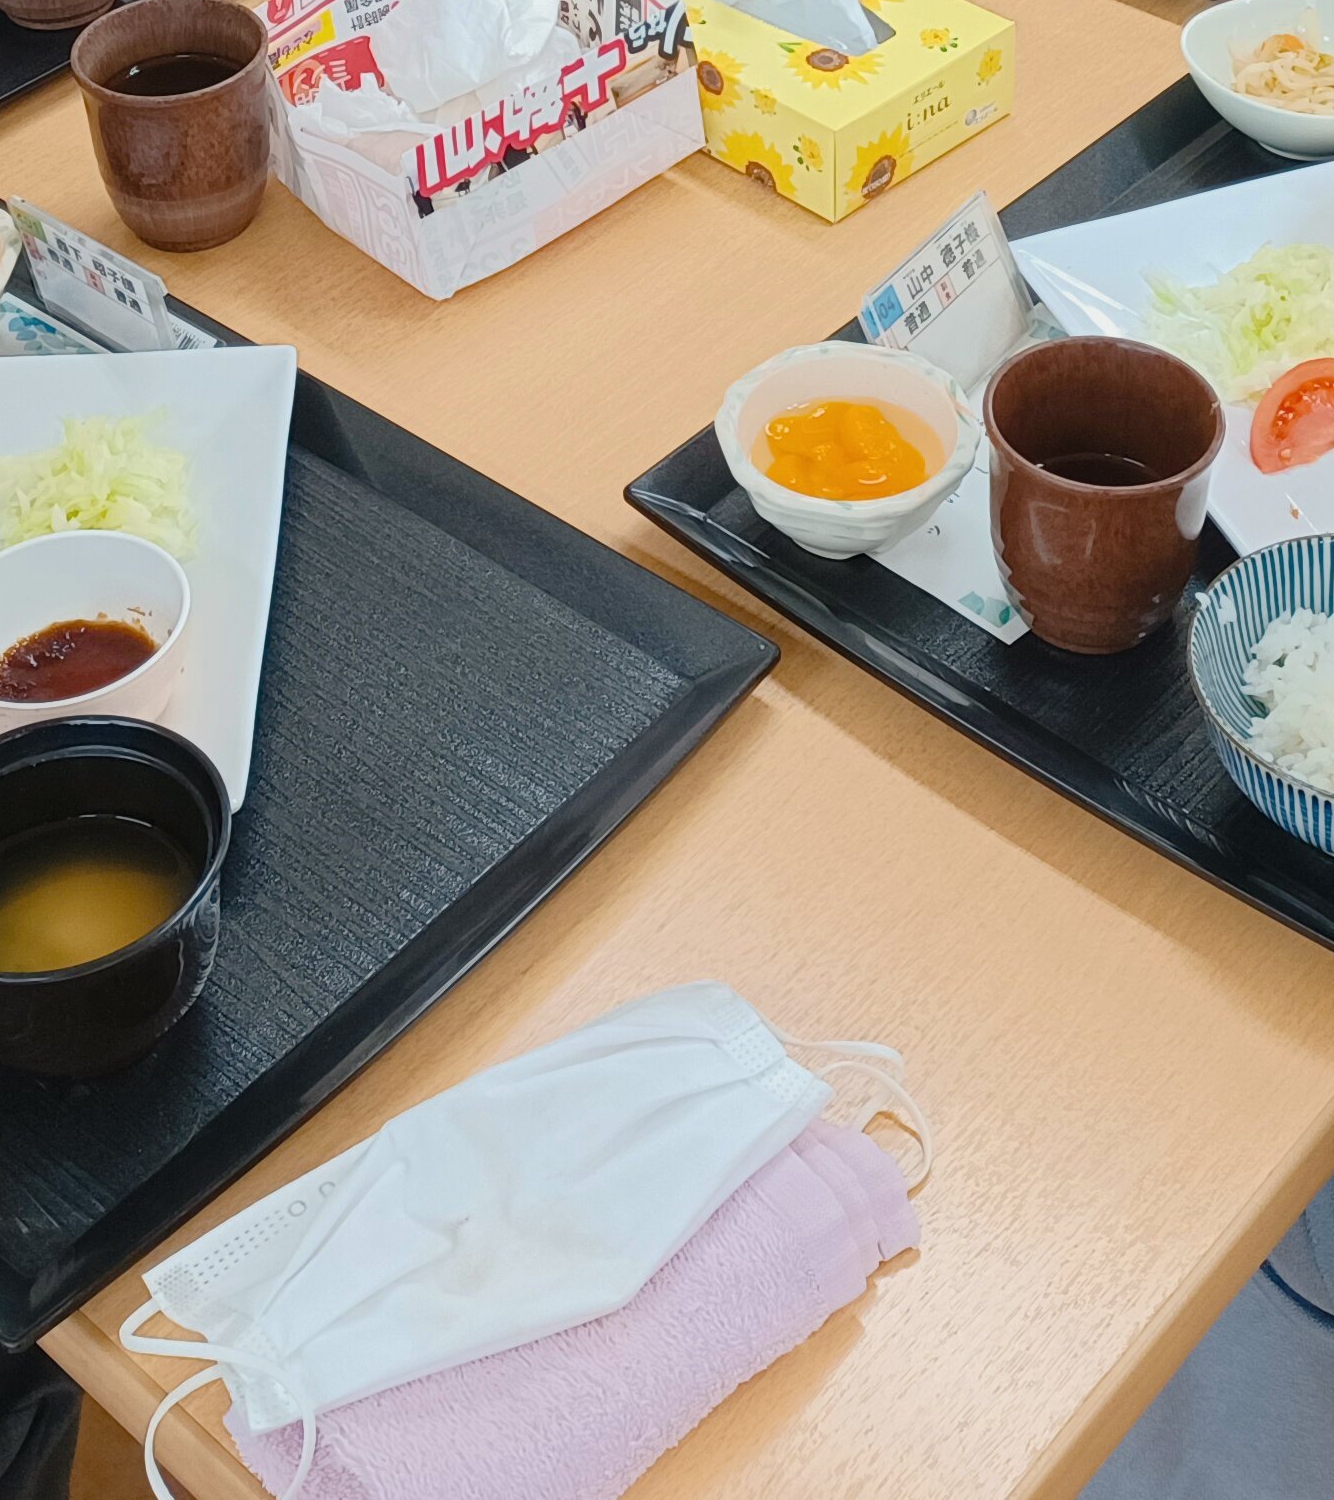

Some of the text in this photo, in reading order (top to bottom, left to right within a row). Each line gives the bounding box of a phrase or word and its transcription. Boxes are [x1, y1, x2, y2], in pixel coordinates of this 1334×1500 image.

[961, 247, 987, 280] 普通
[906, 263, 934, 301] 山中
[903, 300, 932, 336] 普通
